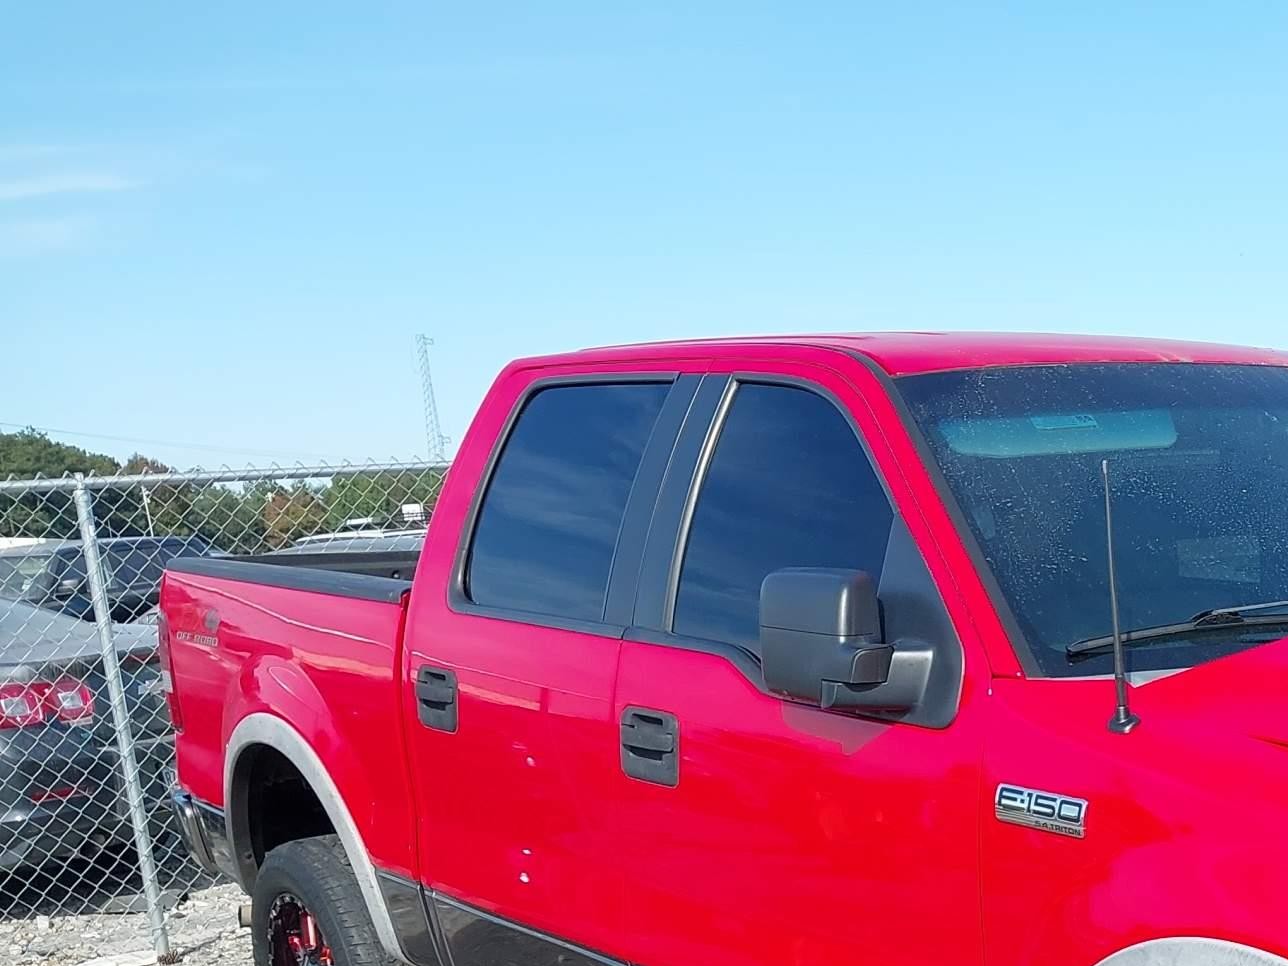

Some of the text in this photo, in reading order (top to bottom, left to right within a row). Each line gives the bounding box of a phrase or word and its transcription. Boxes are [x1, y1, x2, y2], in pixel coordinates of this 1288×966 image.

[176, 631, 219, 647] OFF ROAD
[1050, 823, 1082, 837] TRITON
